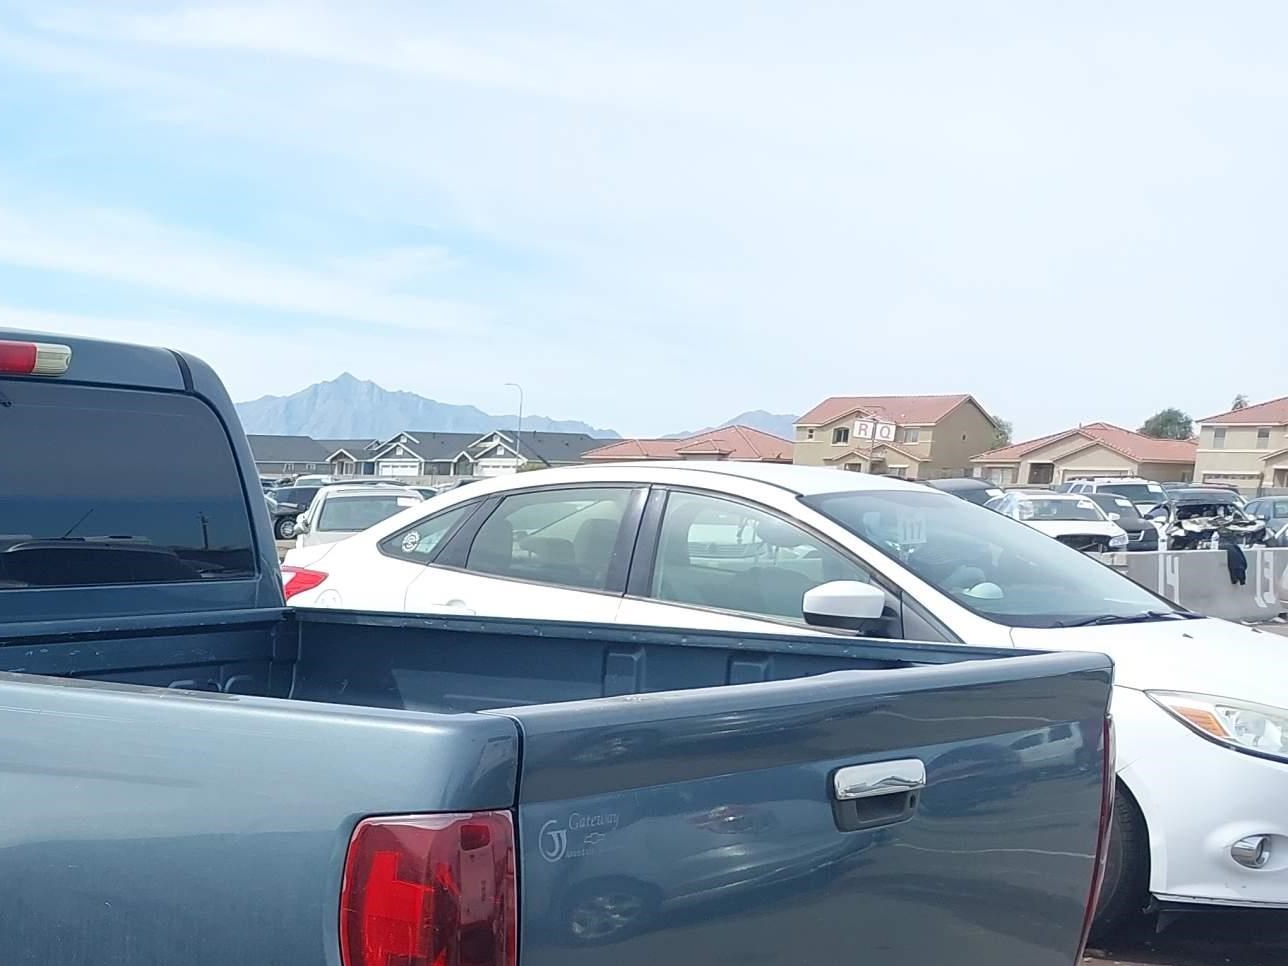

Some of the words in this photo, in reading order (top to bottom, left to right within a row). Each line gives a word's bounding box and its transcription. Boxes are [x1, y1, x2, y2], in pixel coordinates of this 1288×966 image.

[857, 422, 869, 437] R
[878, 425, 892, 440] Q
[1158, 553, 1180, 605] 14
[568, 811, 619, 831] Gateway
